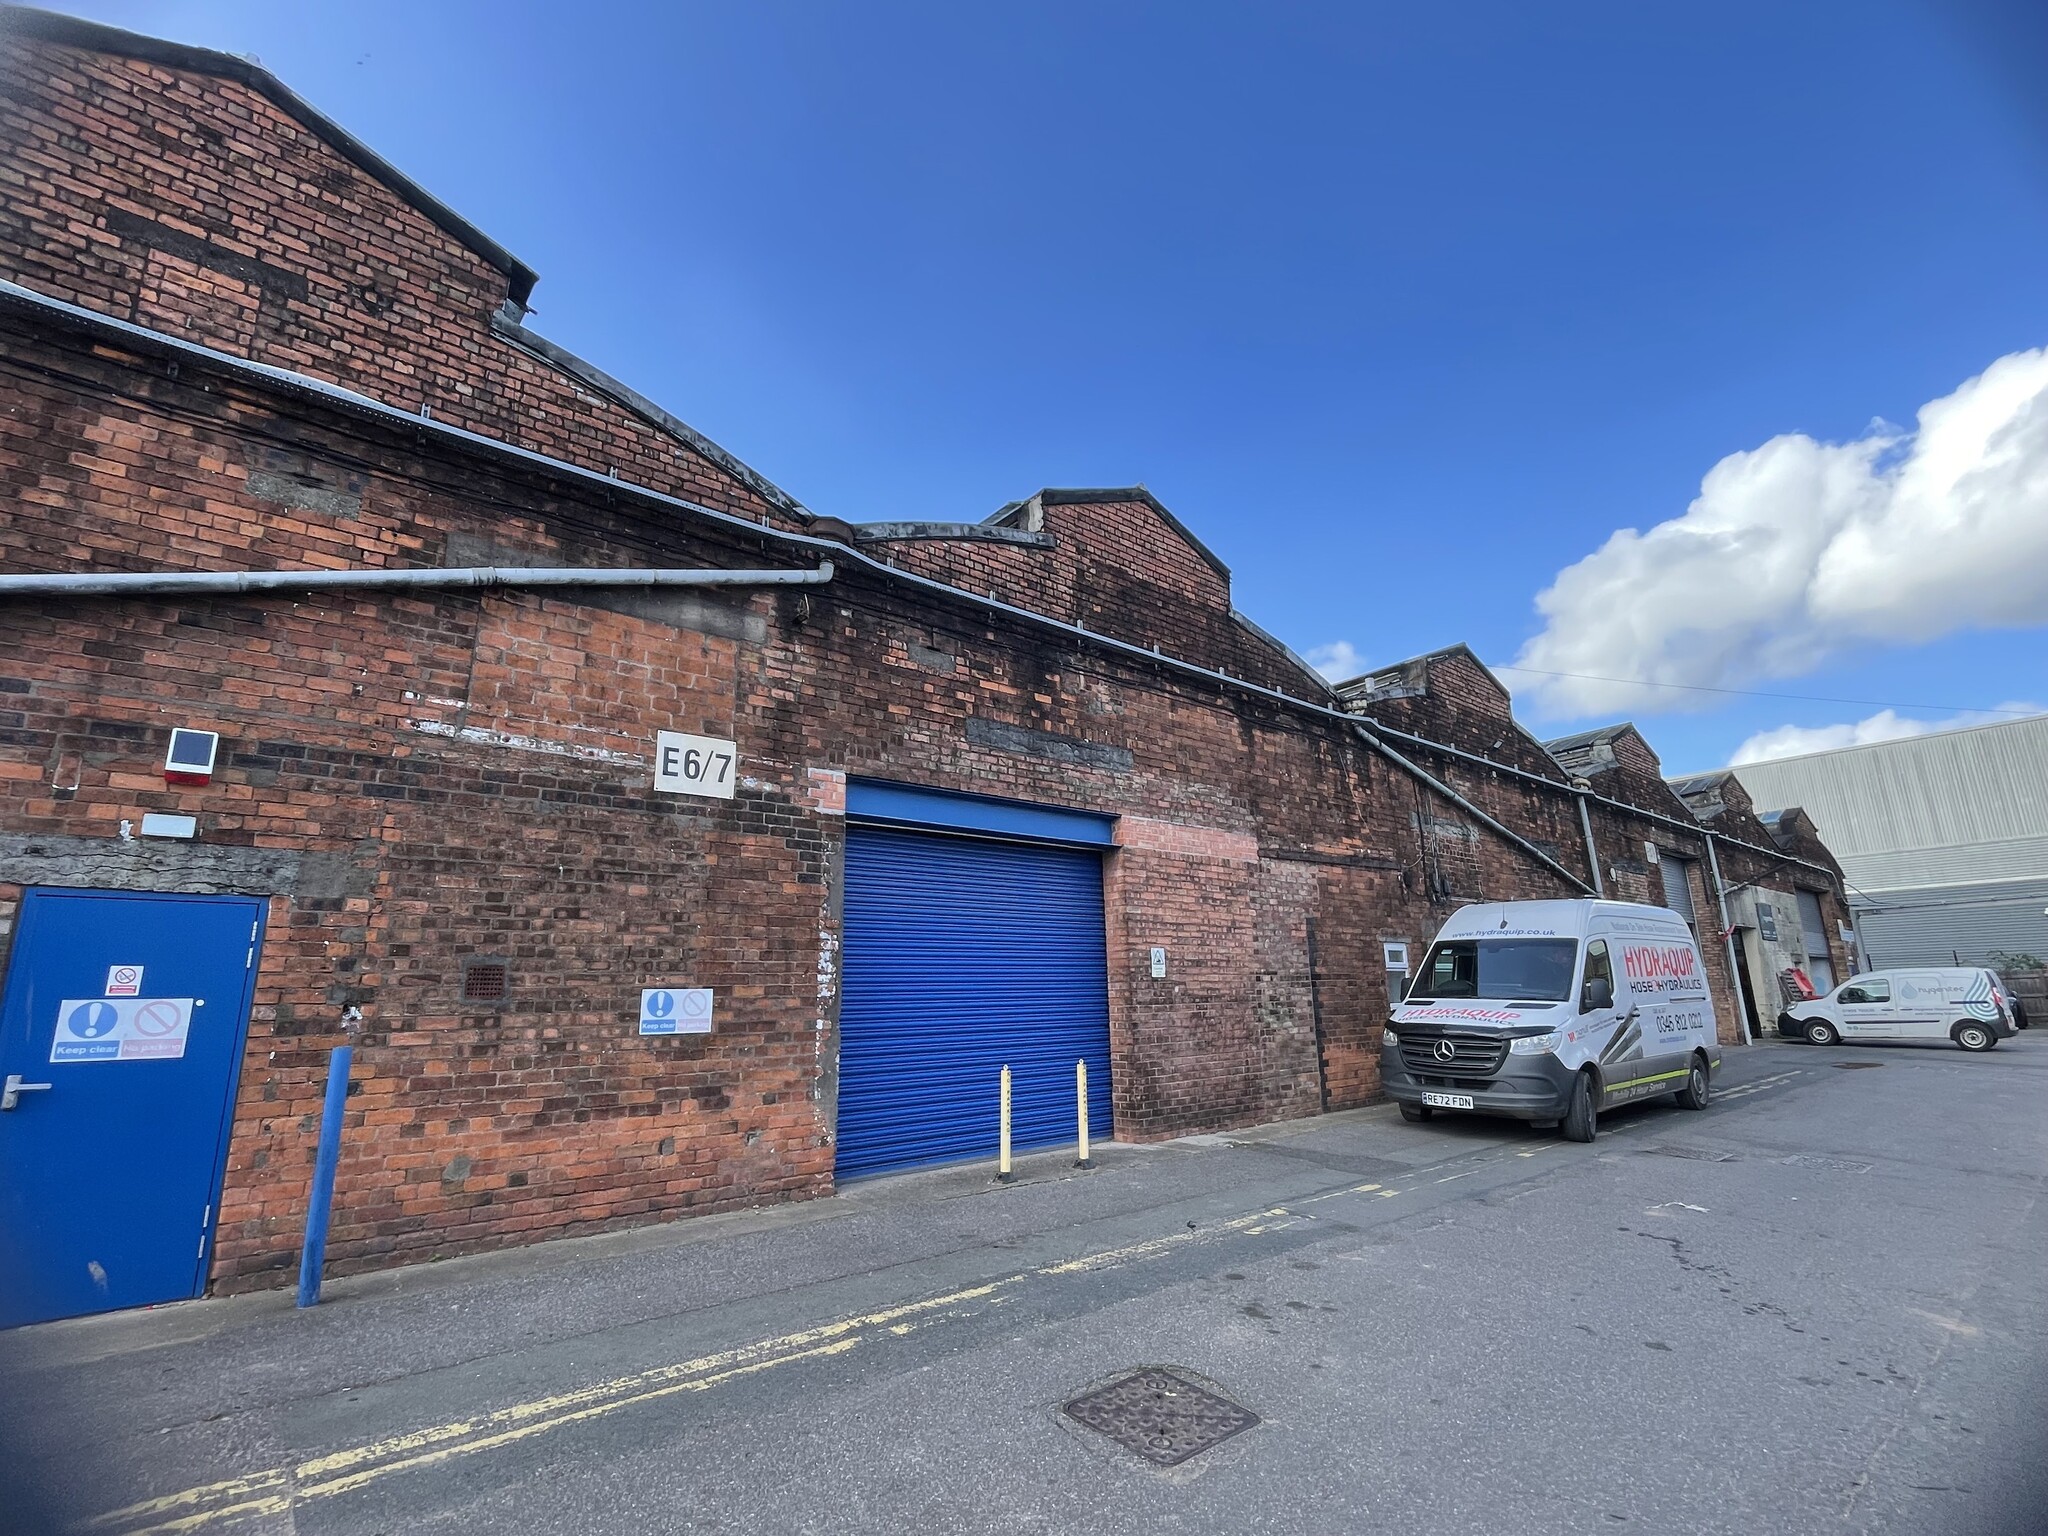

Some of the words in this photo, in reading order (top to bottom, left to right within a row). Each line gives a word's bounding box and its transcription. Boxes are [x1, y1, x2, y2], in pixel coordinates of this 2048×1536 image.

[662, 746, 731, 783] E6/7
[1452, 929, 1556, 938] www.hydraquip.co.uk
[1623, 945, 1694, 979] HYDRAQUIP
[1630, 981, 1652, 993] HOSE
[1659, 979, 1702, 992] HYDRAULICS
[1402, 1008, 1521, 1020] HYDRAQUIP
[1656, 1014, 1675, 1033] 0345
[56, 1046, 87, 1055] Keep
[89, 1044, 118, 1054] clear
[1428, 1095, 1451, 1106] RE72
[1452, 1097, 1471, 1107] FDN
